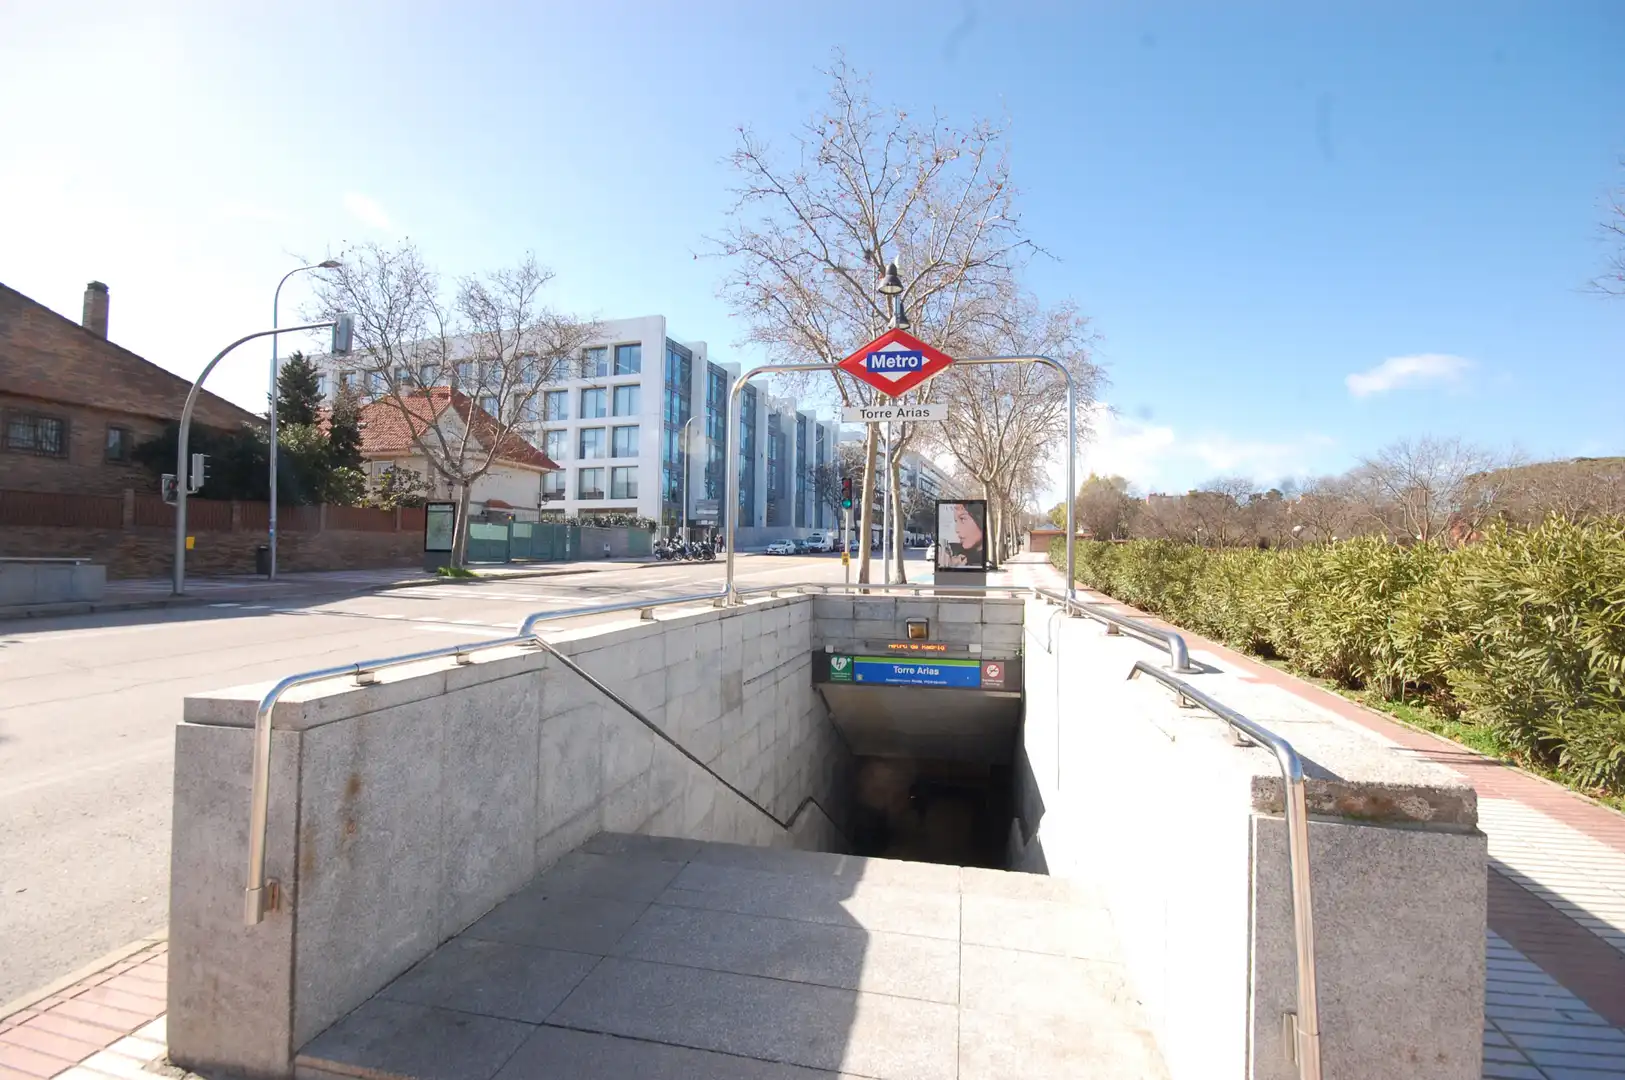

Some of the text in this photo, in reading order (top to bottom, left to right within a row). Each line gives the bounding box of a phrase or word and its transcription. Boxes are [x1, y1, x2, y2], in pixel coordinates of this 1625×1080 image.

[871, 354, 918, 369] Metro
[860, 408, 930, 419] Torre Arias
[893, 665, 940, 676] Torre Arias
